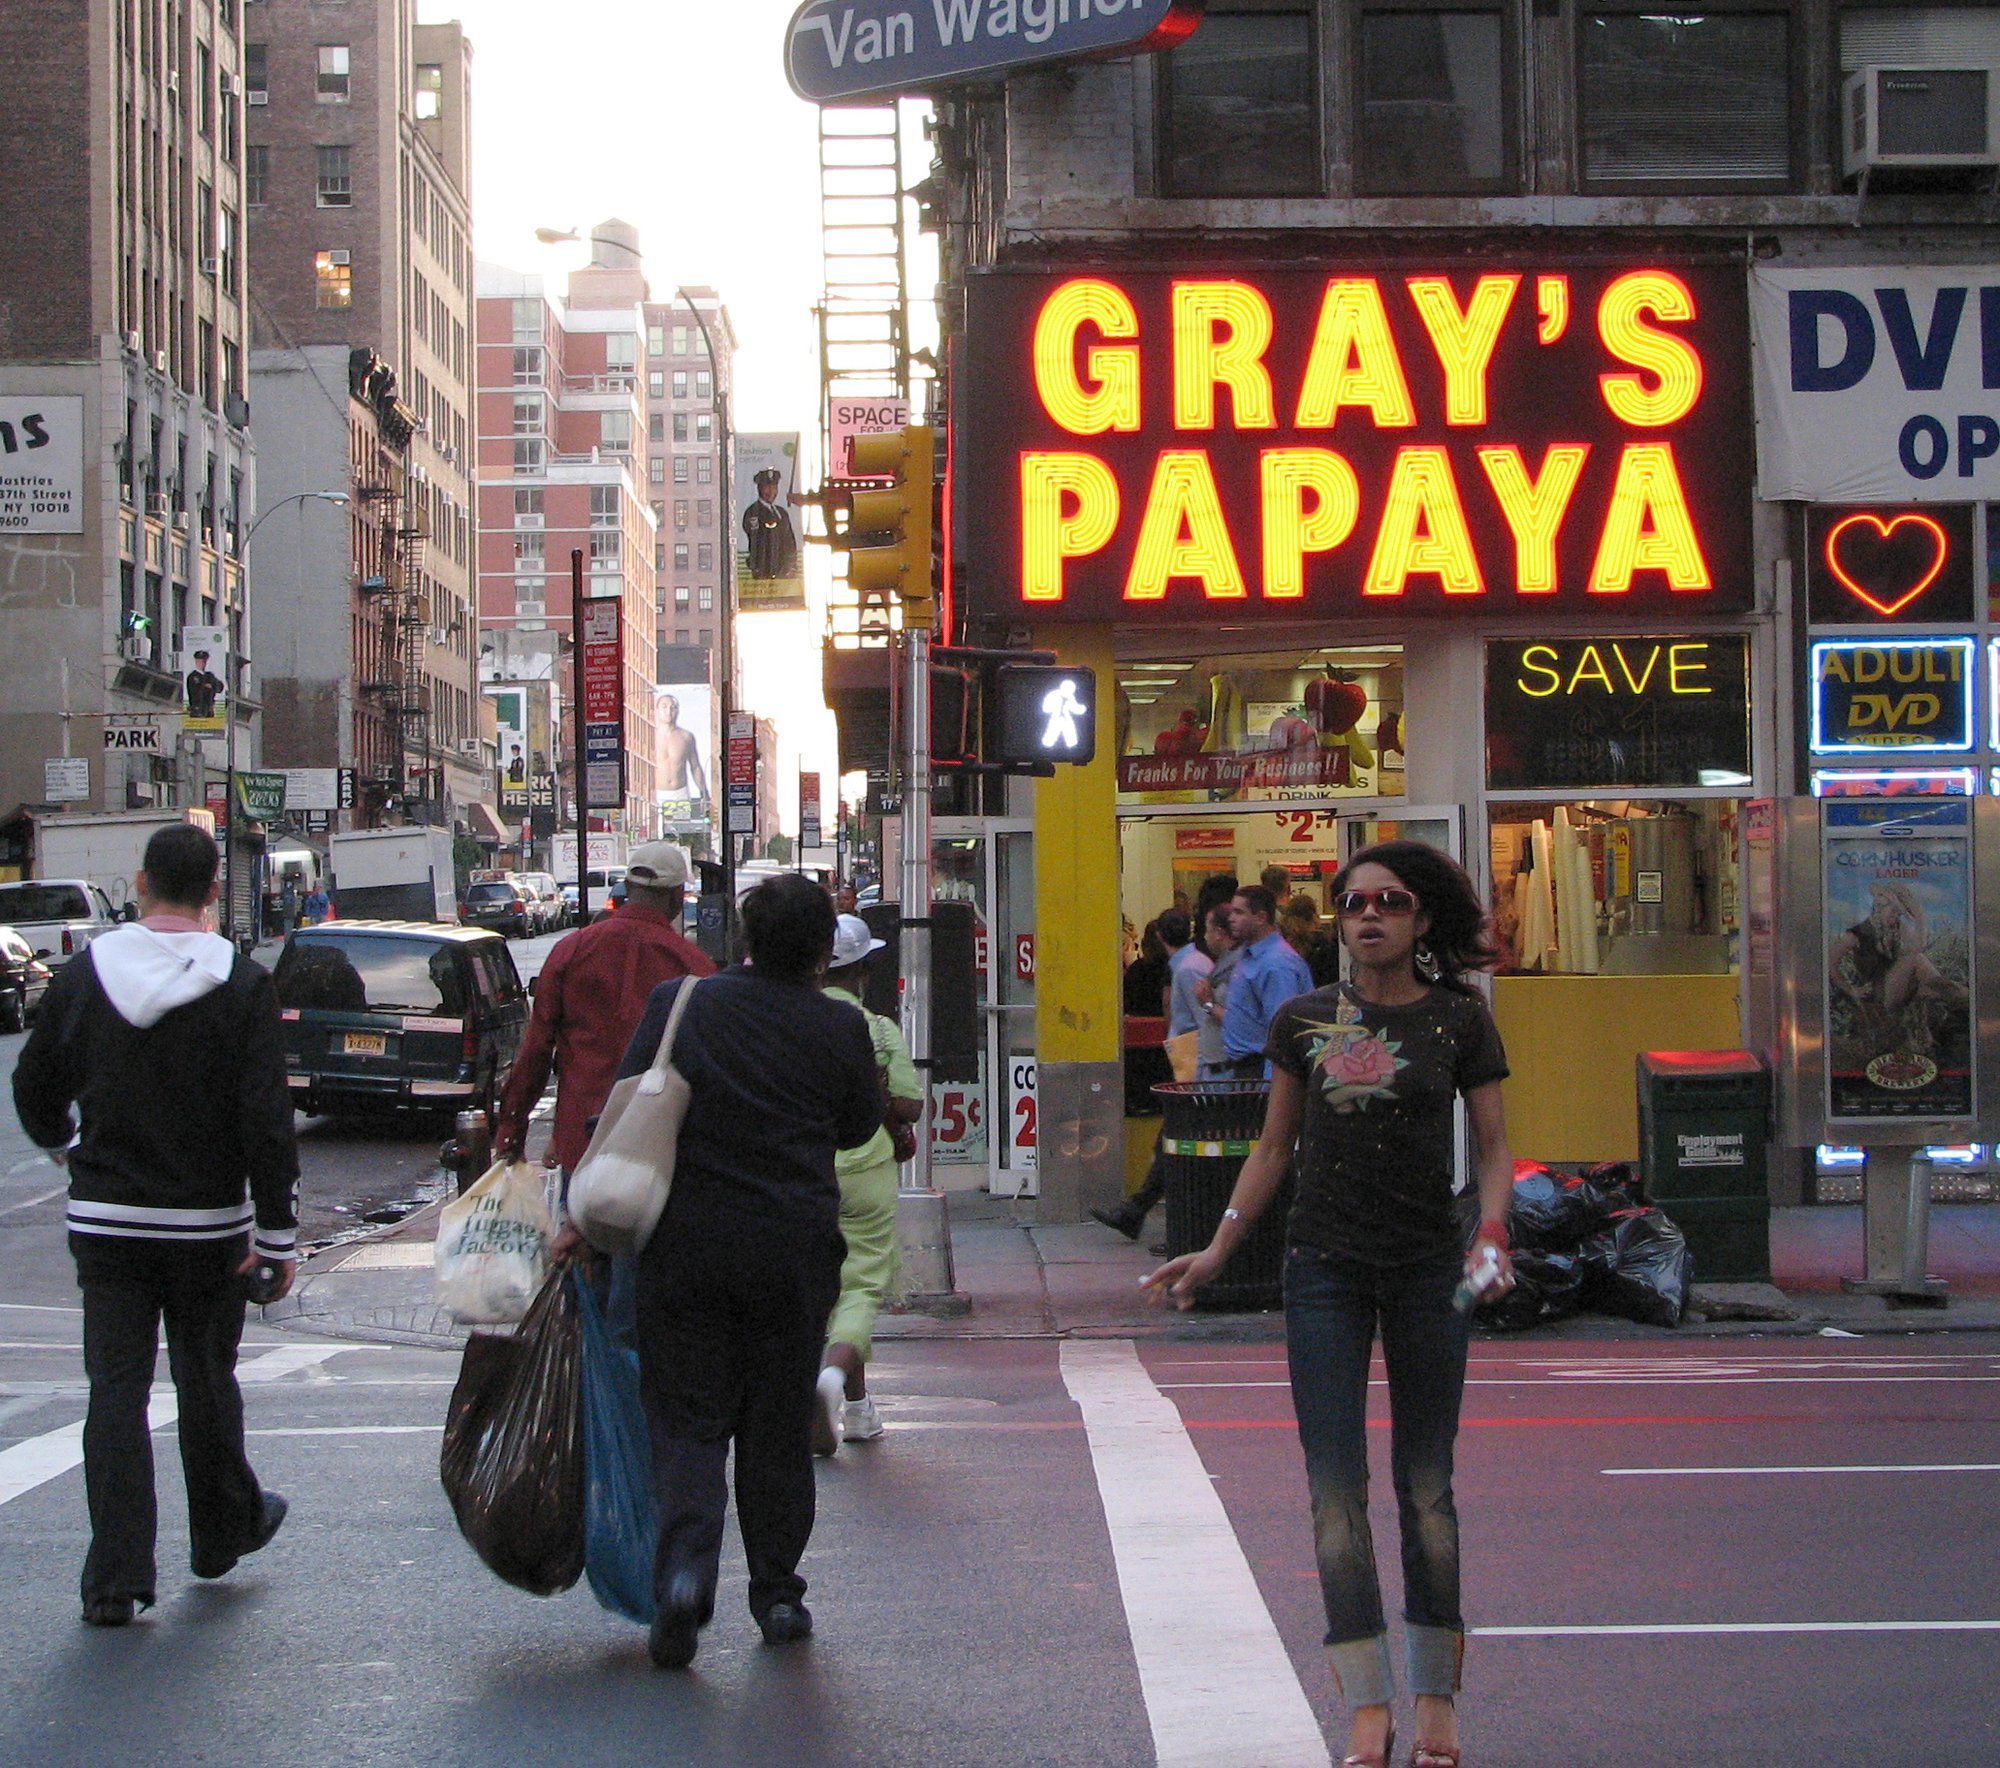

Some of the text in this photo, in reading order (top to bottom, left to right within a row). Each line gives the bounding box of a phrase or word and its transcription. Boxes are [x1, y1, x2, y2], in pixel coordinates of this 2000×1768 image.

[812, 8, 914, 69] Van
[1032, 269, 1702, 434] GRAY'S
[1788, 286, 2000, 392] DV
[838, 407, 907, 425] SPACE
[32, 490, 71, 499] Street
[4, 503, 70, 513] NY 10018
[1019, 441, 1713, 601] PAPAYA
[1517, 643, 1713, 697] SAVE
[1819, 646, 1966, 683] ADULT
[1847, 692, 1941, 732] DVD
[104, 729, 158, 749] PARK
[1127, 762, 1177, 783] Franks
[1183, 758, 1210, 781] For
[1215, 757, 1247, 779] Your
[502, 791, 553, 806] HERE
[1836, 851, 1962, 868] CORNHUSKER
[1677, 1133, 1744, 1147] Employment
